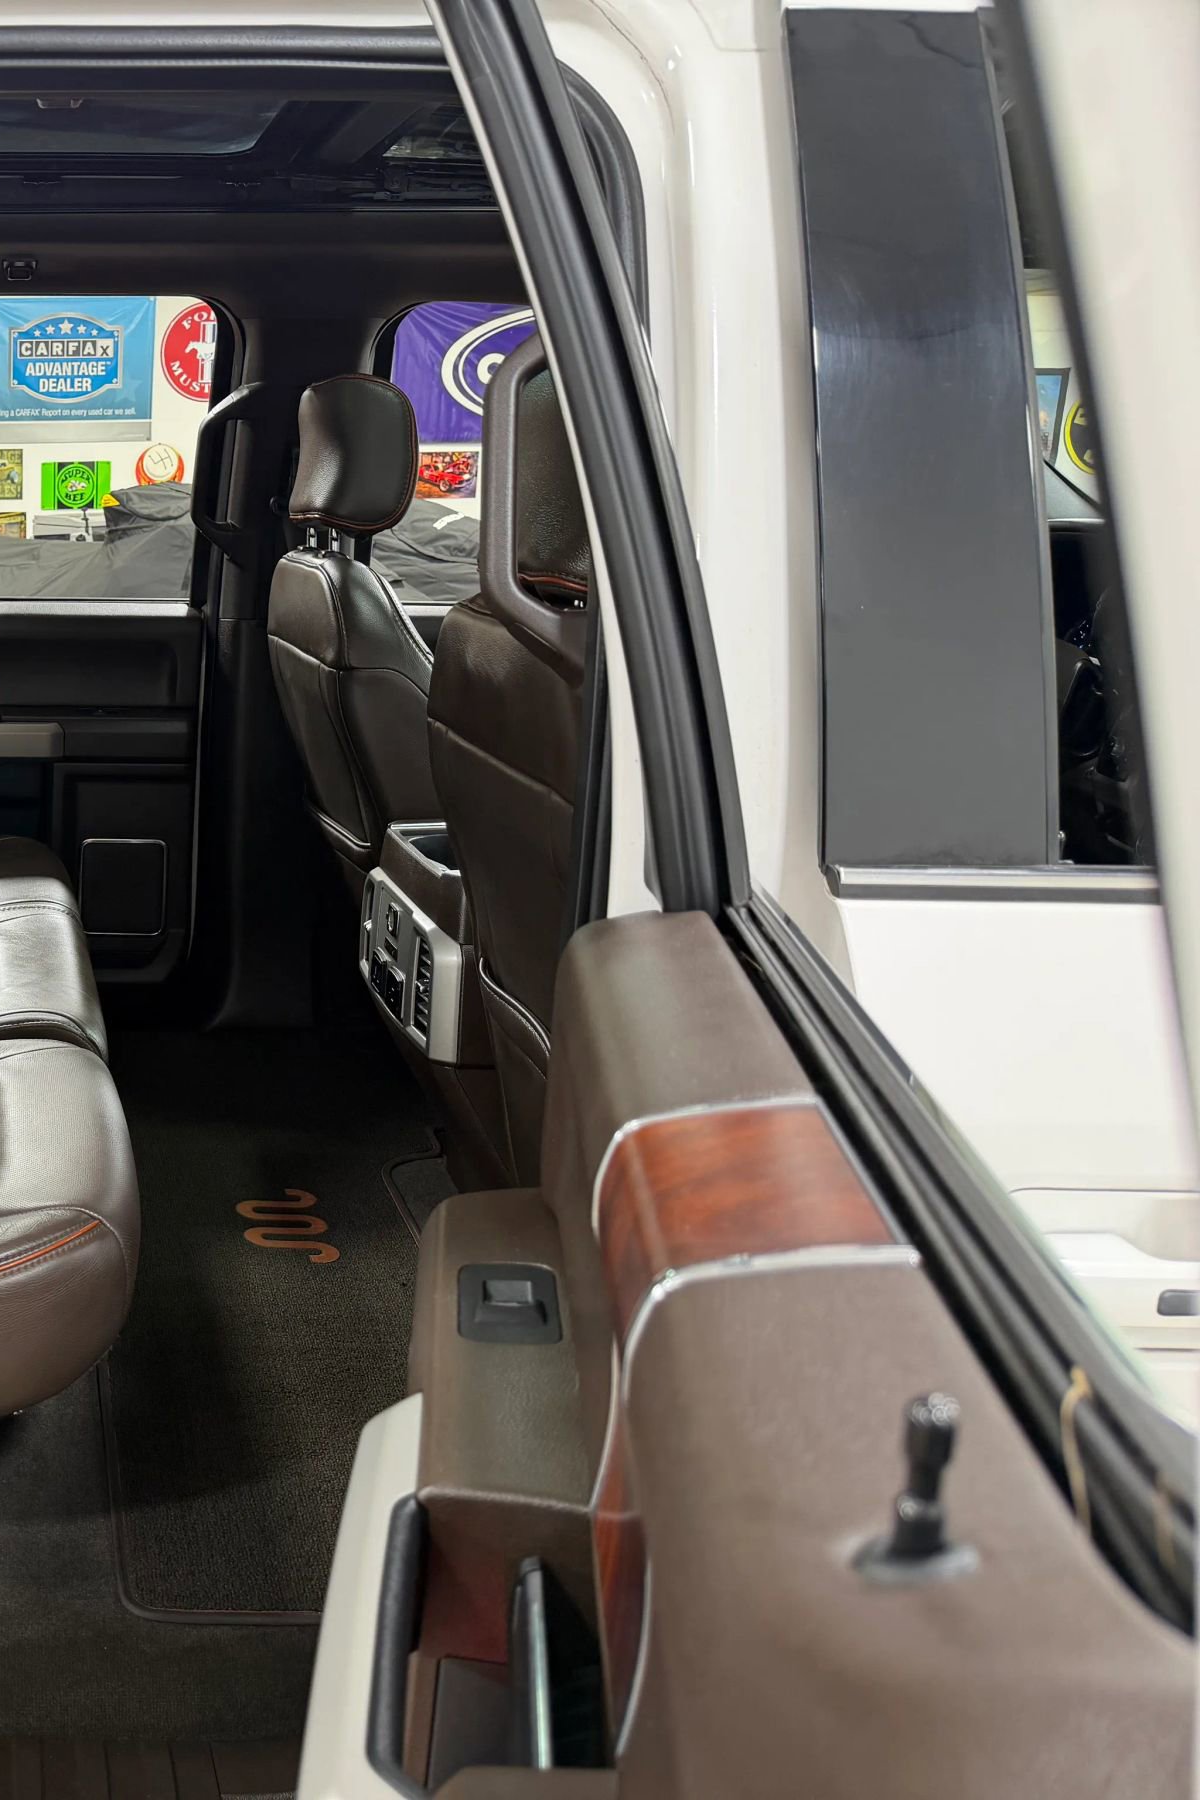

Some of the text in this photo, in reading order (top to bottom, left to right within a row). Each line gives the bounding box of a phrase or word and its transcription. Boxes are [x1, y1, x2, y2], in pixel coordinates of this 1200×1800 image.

[20, 342, 110, 356] CARFAX
[39, 378, 92, 392] DEALER
[41, 408, 61, 417] Report
[88, 408, 102, 416] used
[124, 407, 136, 416] sell.
[61, 469, 91, 483] SUPER
[65, 492, 85, 501] BEE
